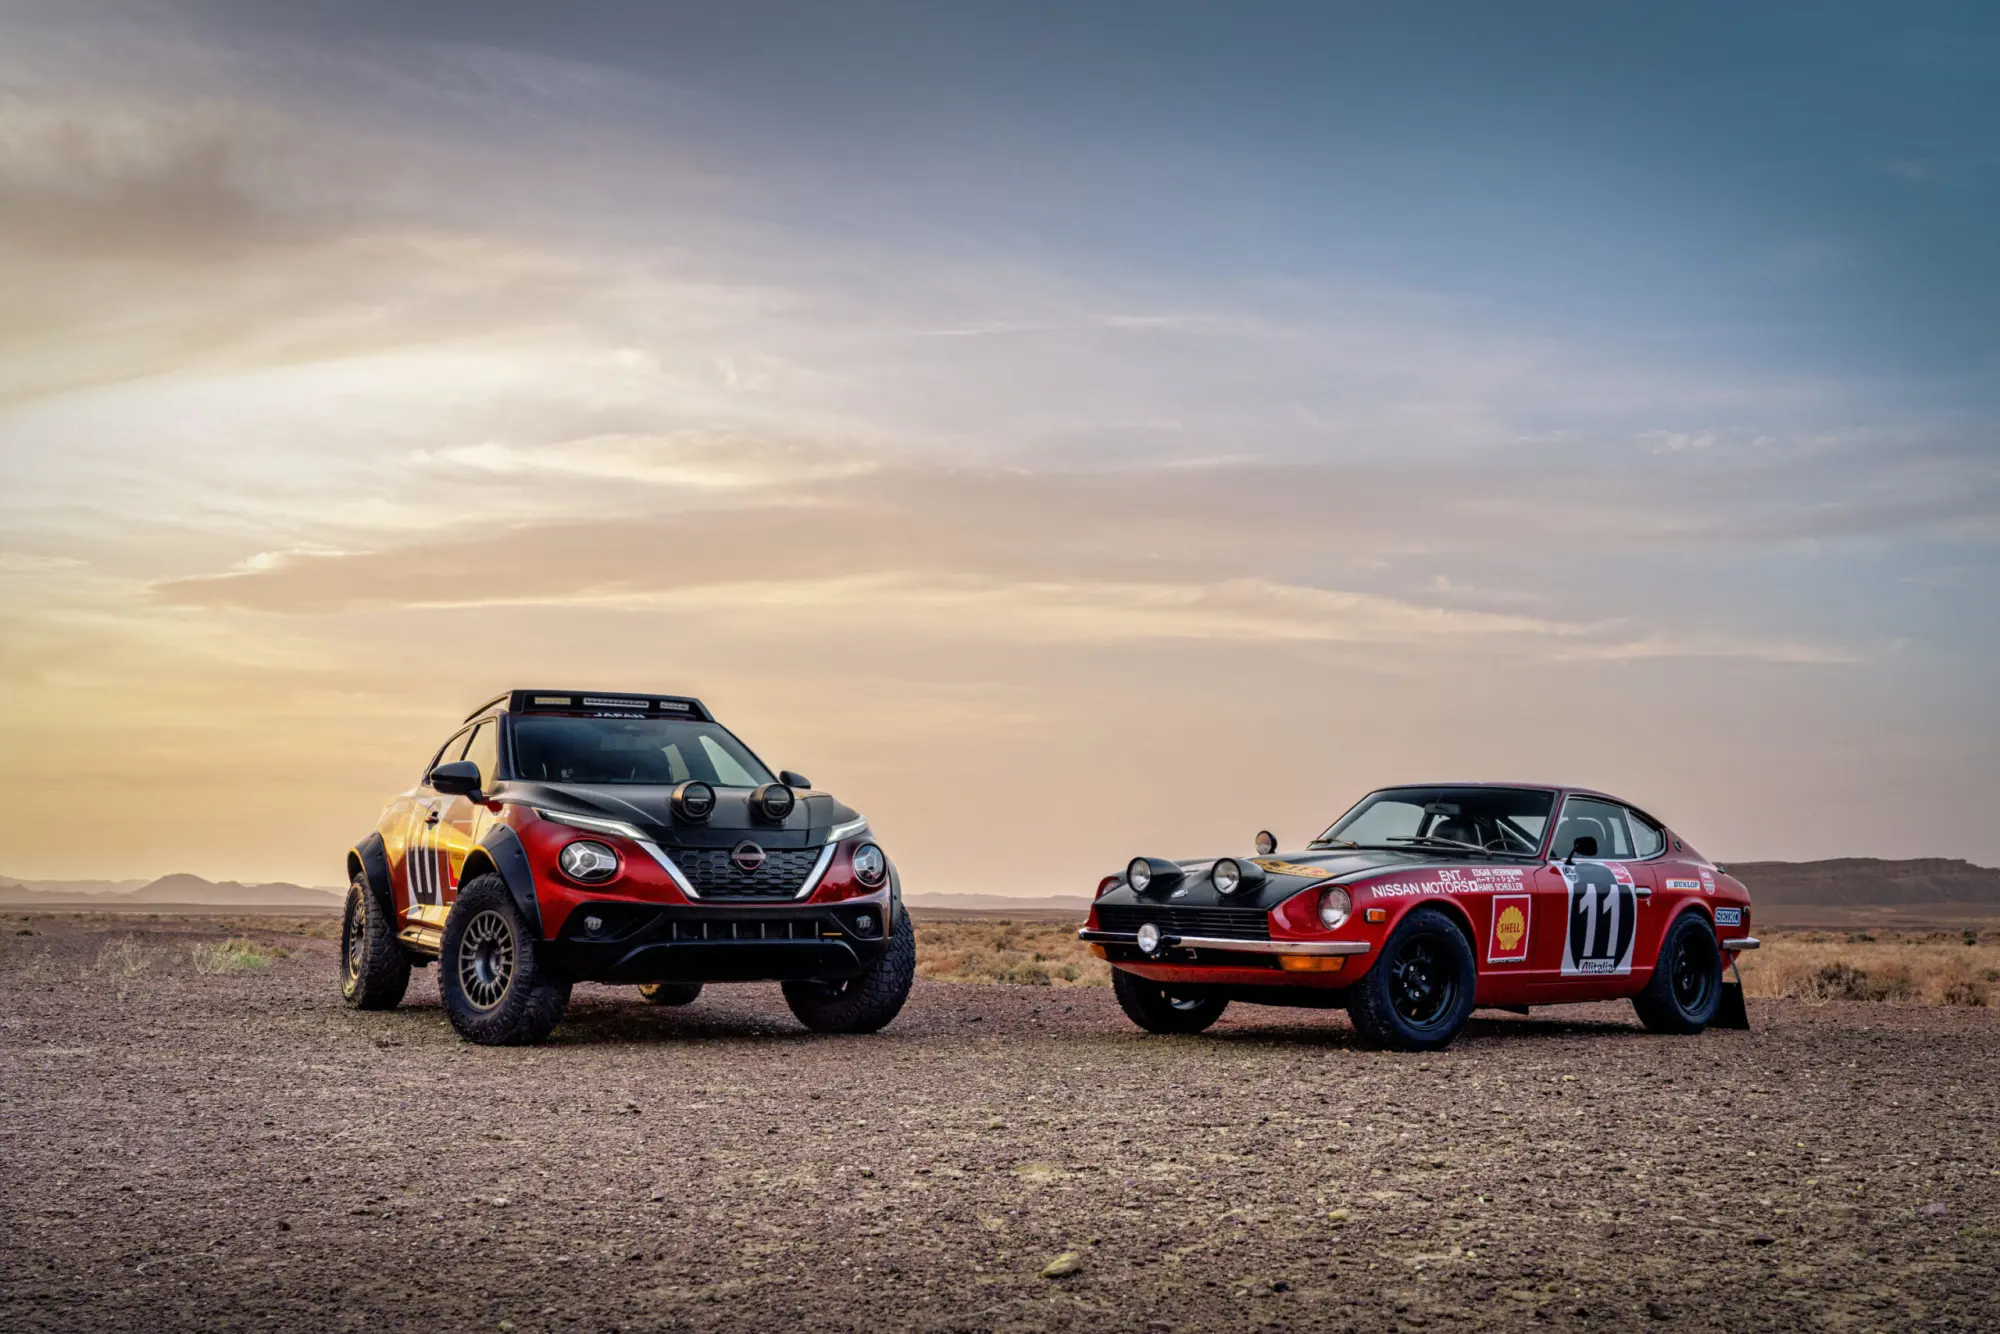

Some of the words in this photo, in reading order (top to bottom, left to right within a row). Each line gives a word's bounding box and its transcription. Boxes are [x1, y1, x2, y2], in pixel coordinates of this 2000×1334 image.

[1438, 870, 1466, 882] ENT.
[1371, 883, 1421, 898] NISSAN
[1422, 880, 1469, 894] MOTORS
[1477, 883, 1495, 892] HANS
[1673, 880, 1699, 888] DUNLOP
[1579, 883, 1620, 957] 11
[1715, 911, 1740, 923] SEIKO
[1500, 923, 1521, 934] SHELL
[1580, 961, 1614, 974] Alitalia
